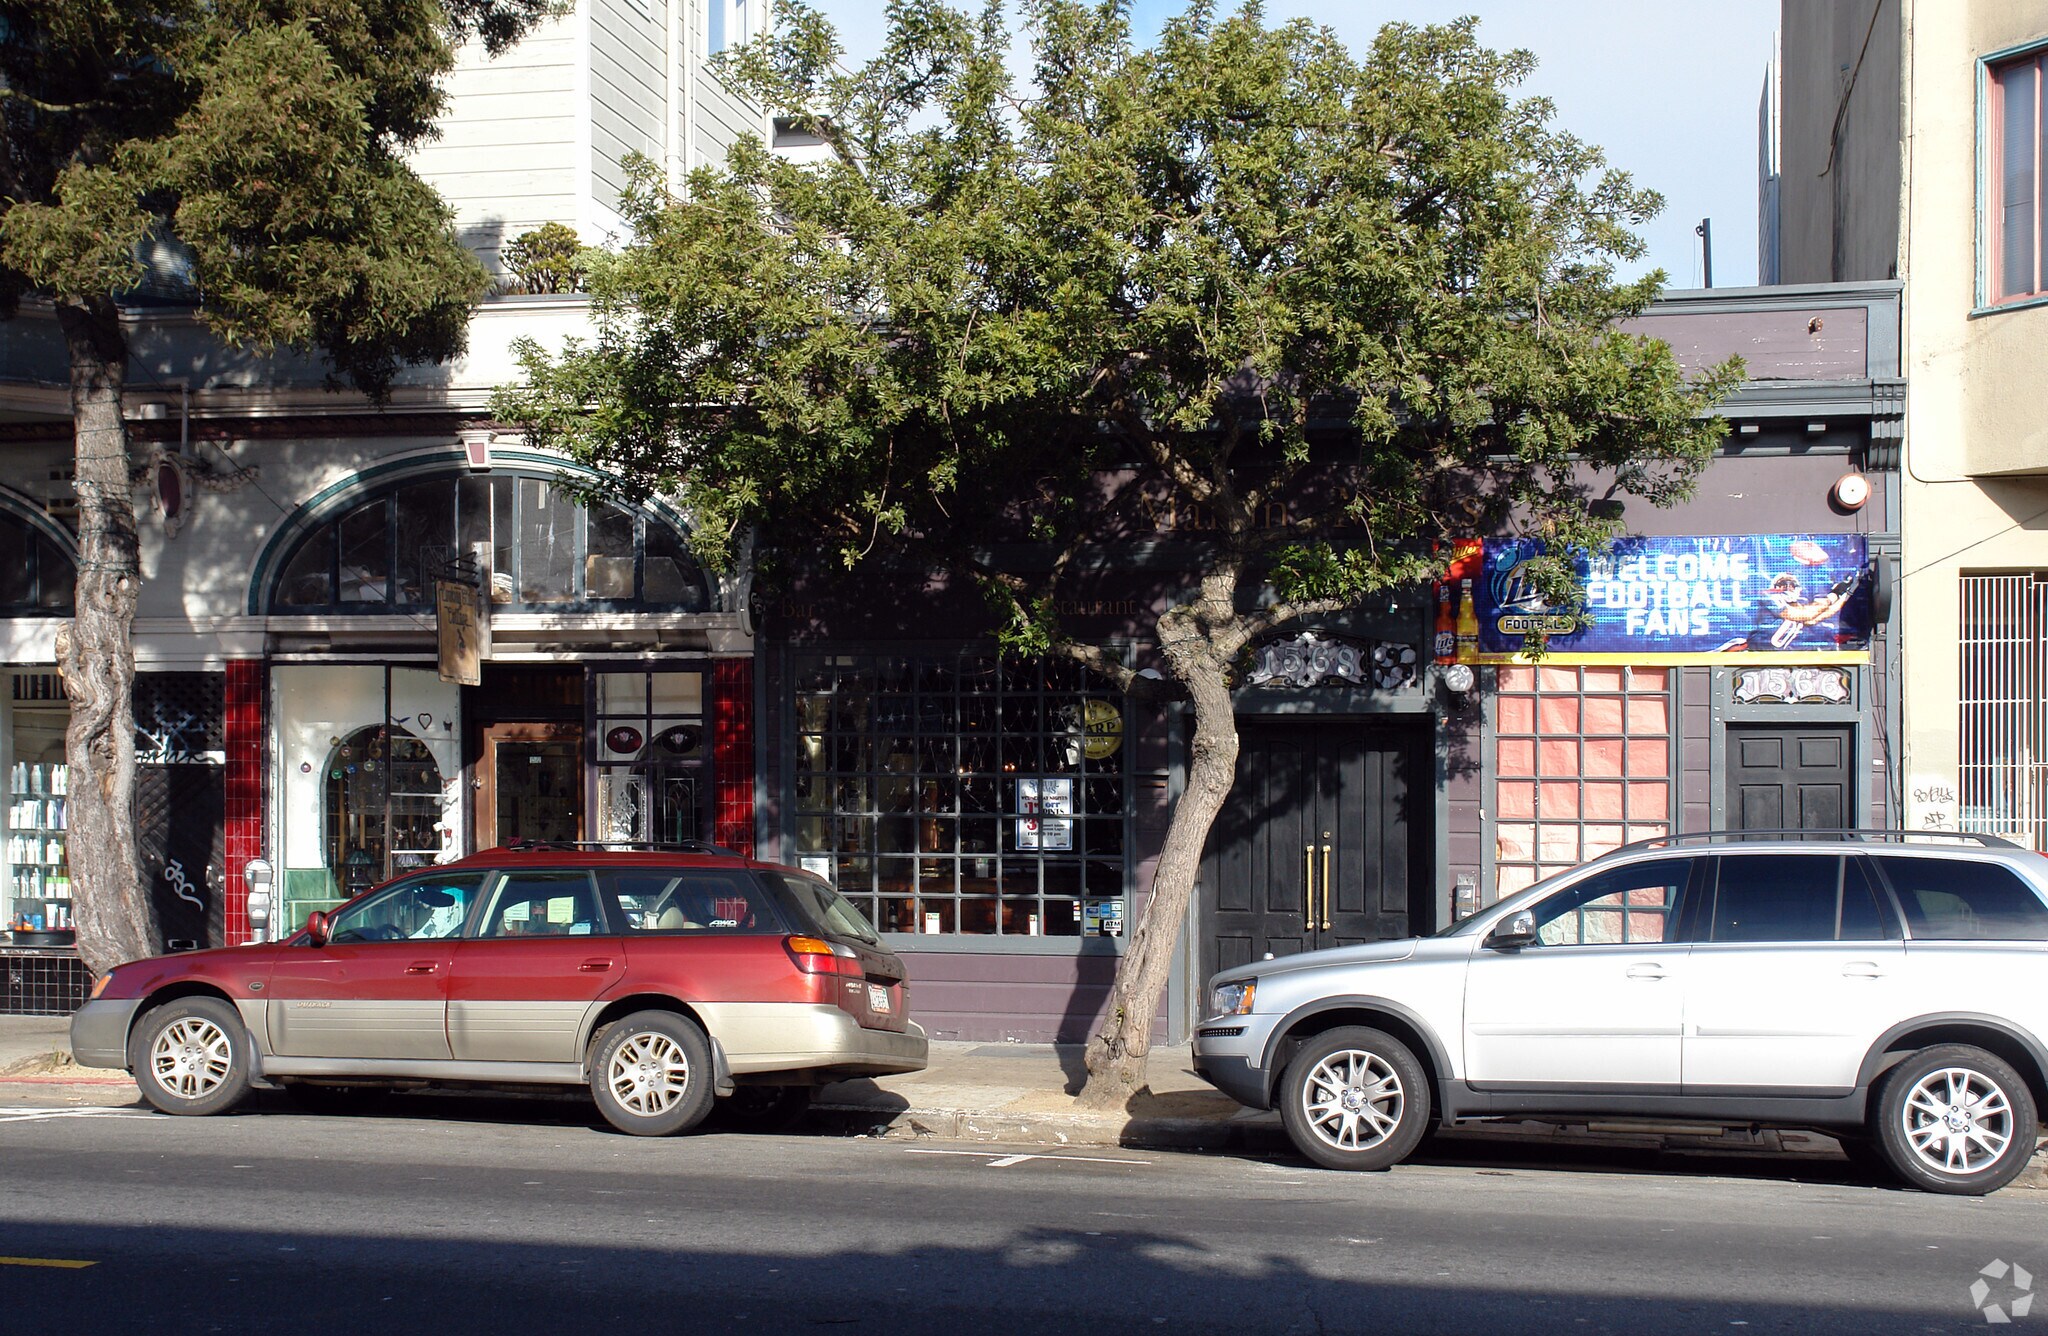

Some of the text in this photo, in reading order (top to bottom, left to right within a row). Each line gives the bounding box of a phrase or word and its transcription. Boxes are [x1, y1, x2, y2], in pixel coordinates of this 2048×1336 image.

[1589, 553, 1749, 582] WELCOME
[780, 597, 818, 618] Bar
[1053, 599, 1137, 616] staurant
[1586, 580, 1751, 609] FOOTBALL
[1505, 618, 1569, 630] FOOTBAL
[1625, 607, 1710, 636] FANS
[1261, 645, 1356, 677] 1568
[1744, 669, 1839, 697] 1566
[1085, 722, 1116, 734] ARP
[709, 919, 738, 927] AWD
